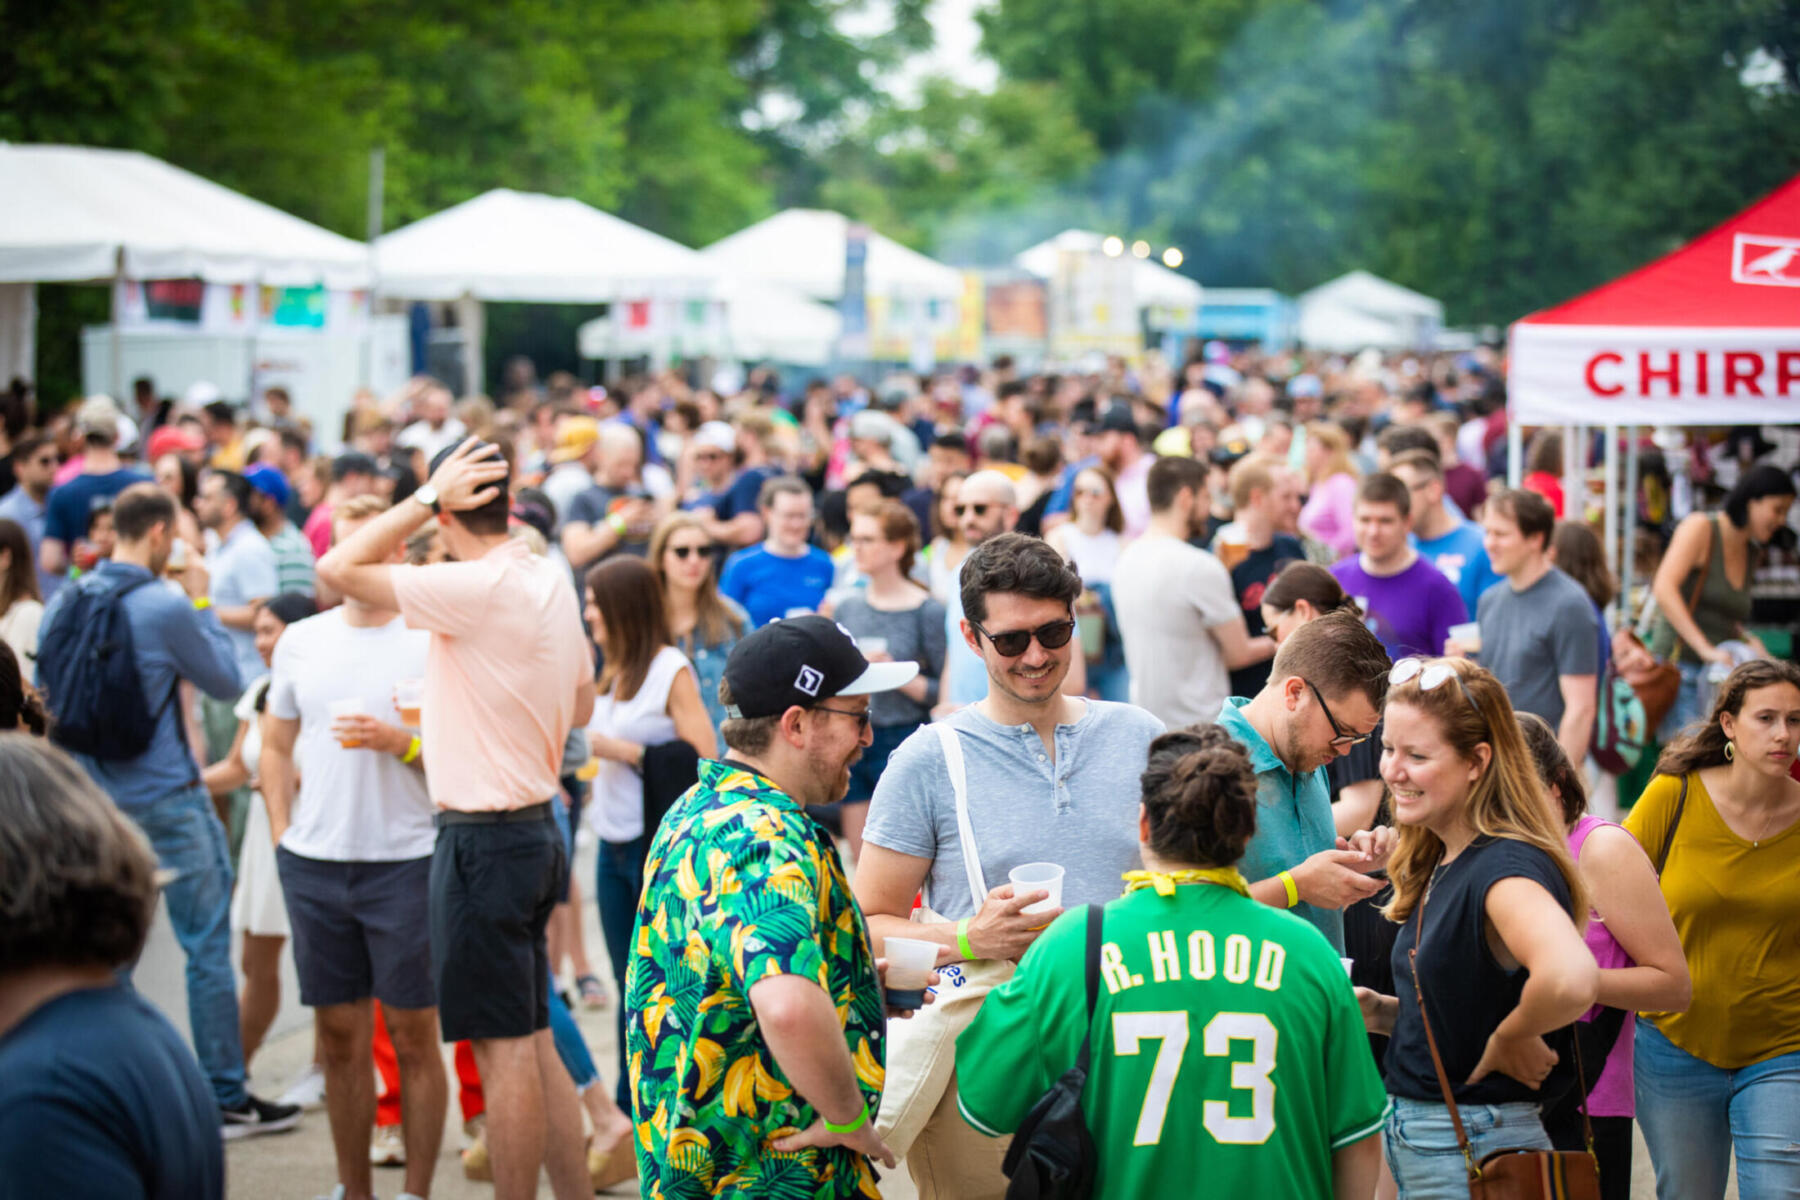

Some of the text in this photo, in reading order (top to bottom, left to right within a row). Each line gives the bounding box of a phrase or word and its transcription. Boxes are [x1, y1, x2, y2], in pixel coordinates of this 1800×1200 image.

[1101, 930, 1286, 995] R. HOOD
[1111, 1011, 1278, 1146] 73
